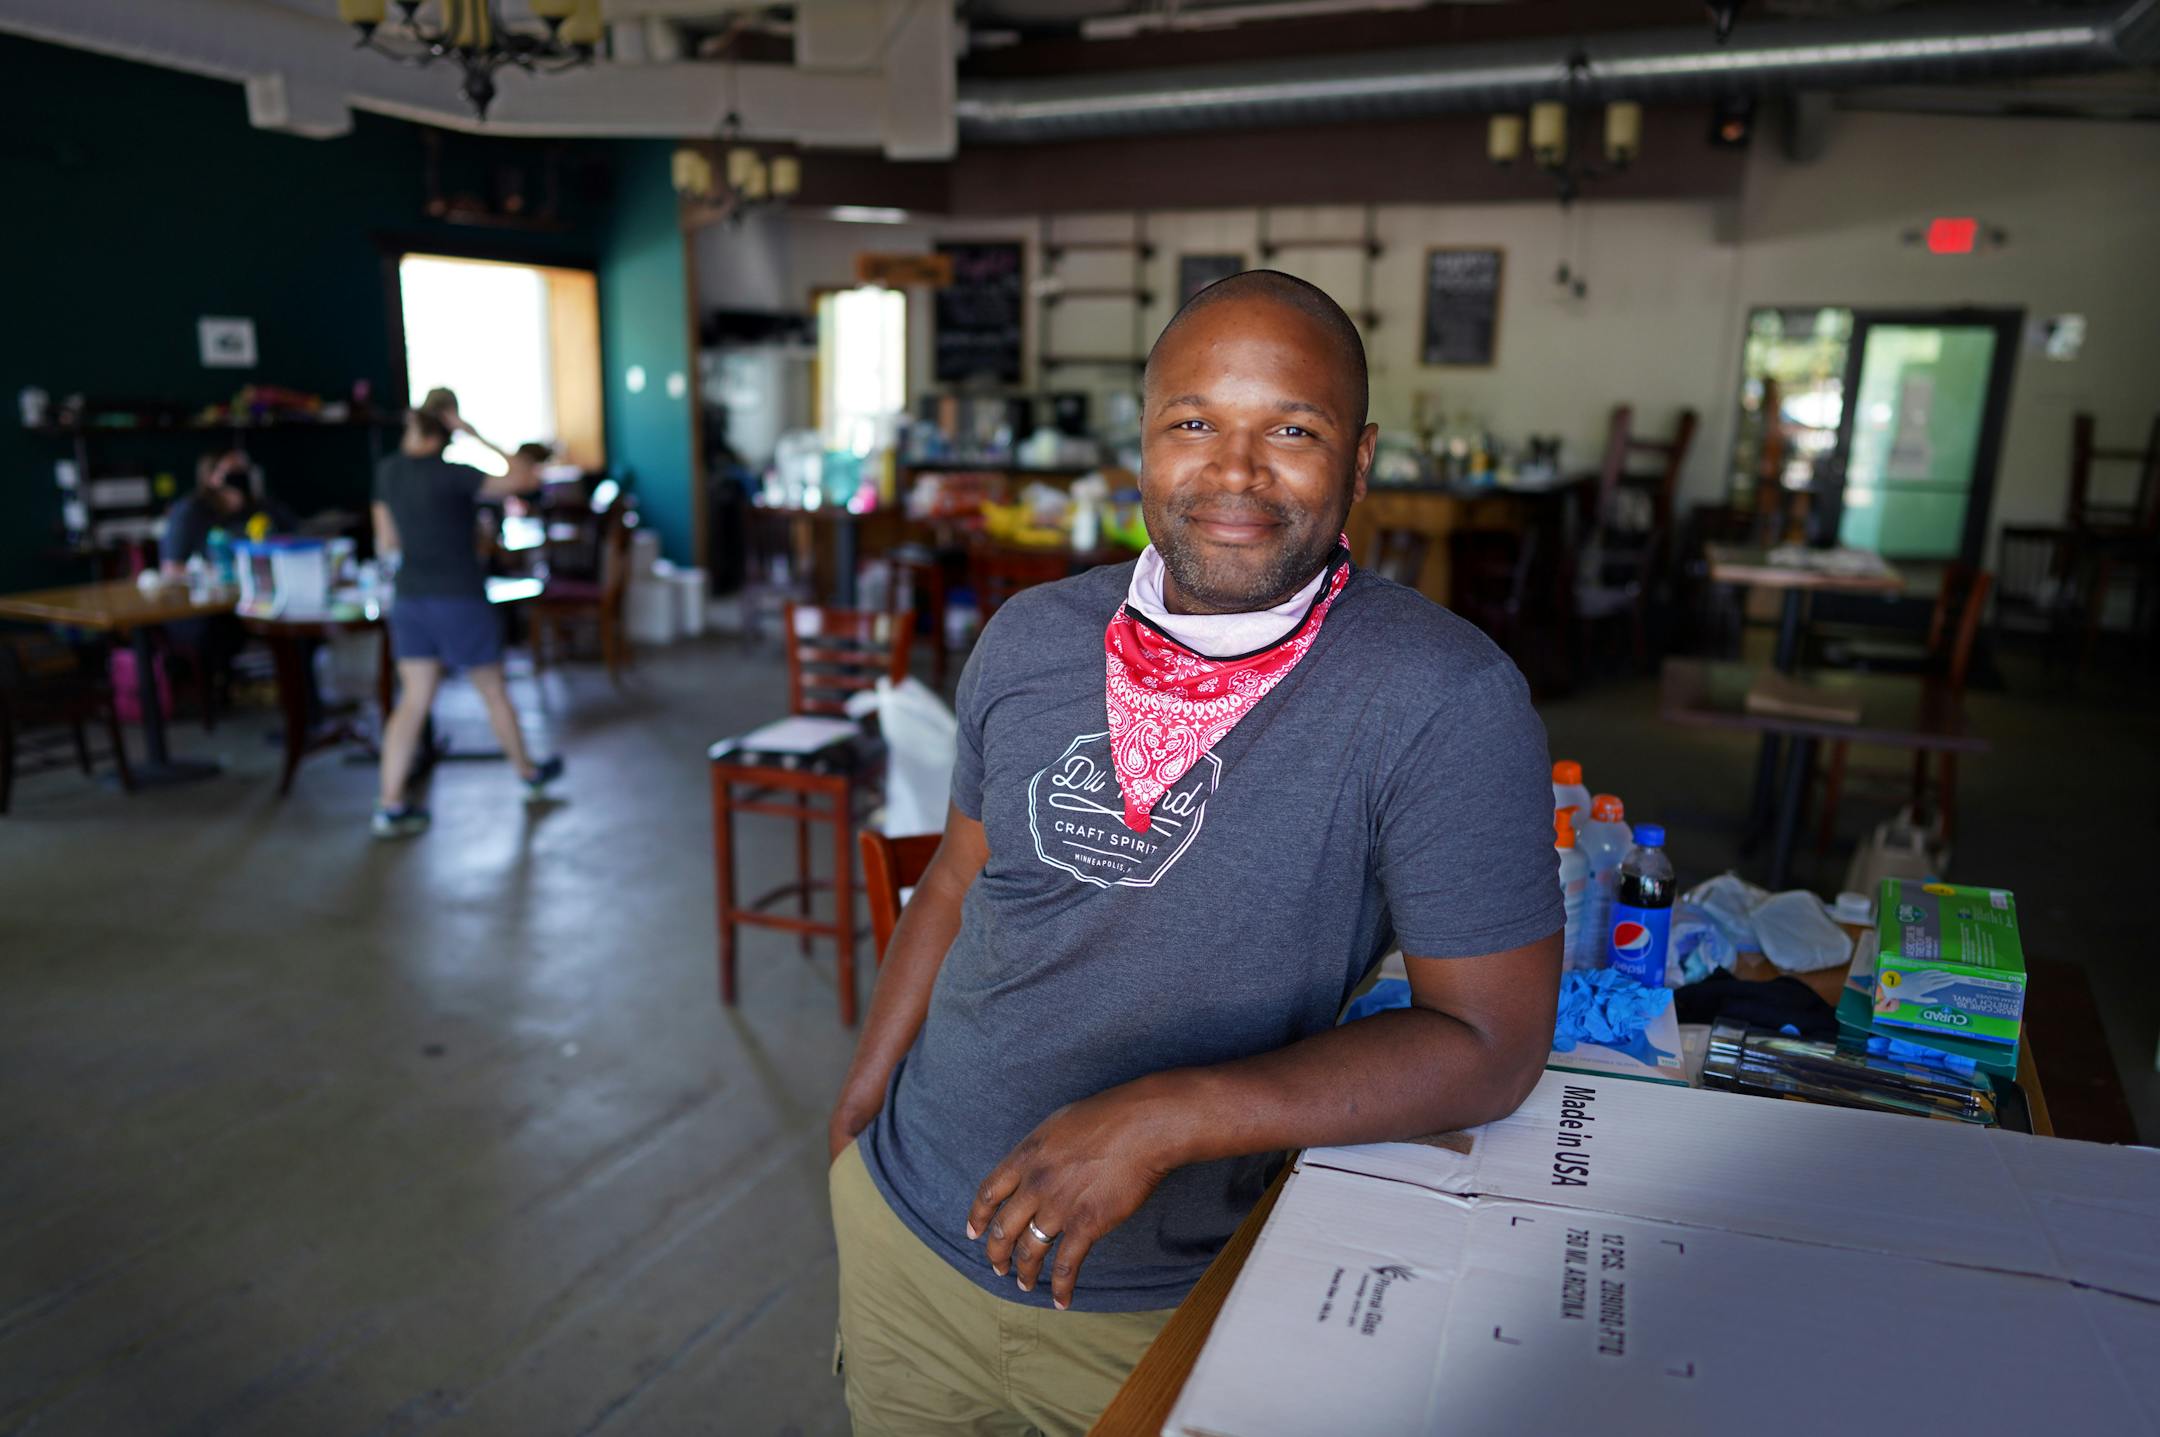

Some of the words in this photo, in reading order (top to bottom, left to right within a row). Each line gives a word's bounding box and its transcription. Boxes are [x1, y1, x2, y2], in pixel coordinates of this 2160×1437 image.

[1055, 820, 1105, 842] CRAFT
[1613, 960, 1646, 976] pepsi
[1952, 994, 1978, 1005] VINYL
[1980, 1000, 2019, 1010] STRETCH
[1970, 1004, 1993, 1014] CARE
[1993, 1007, 2019, 1017] BASIC
[1923, 1010, 1968, 1026] CURAD
[1559, 1084, 1596, 1129] Made
[1557, 1132, 1593, 1148] in
[1551, 1151, 1591, 1187] USA
[1566, 1228, 1590, 1248] 750
[1602, 1233, 1624, 1246] 12
[1563, 1248, 1588, 1265] ML
[1602, 1247, 1624, 1270] PCS.
[1561, 1267, 1586, 1319] ARIZONA
